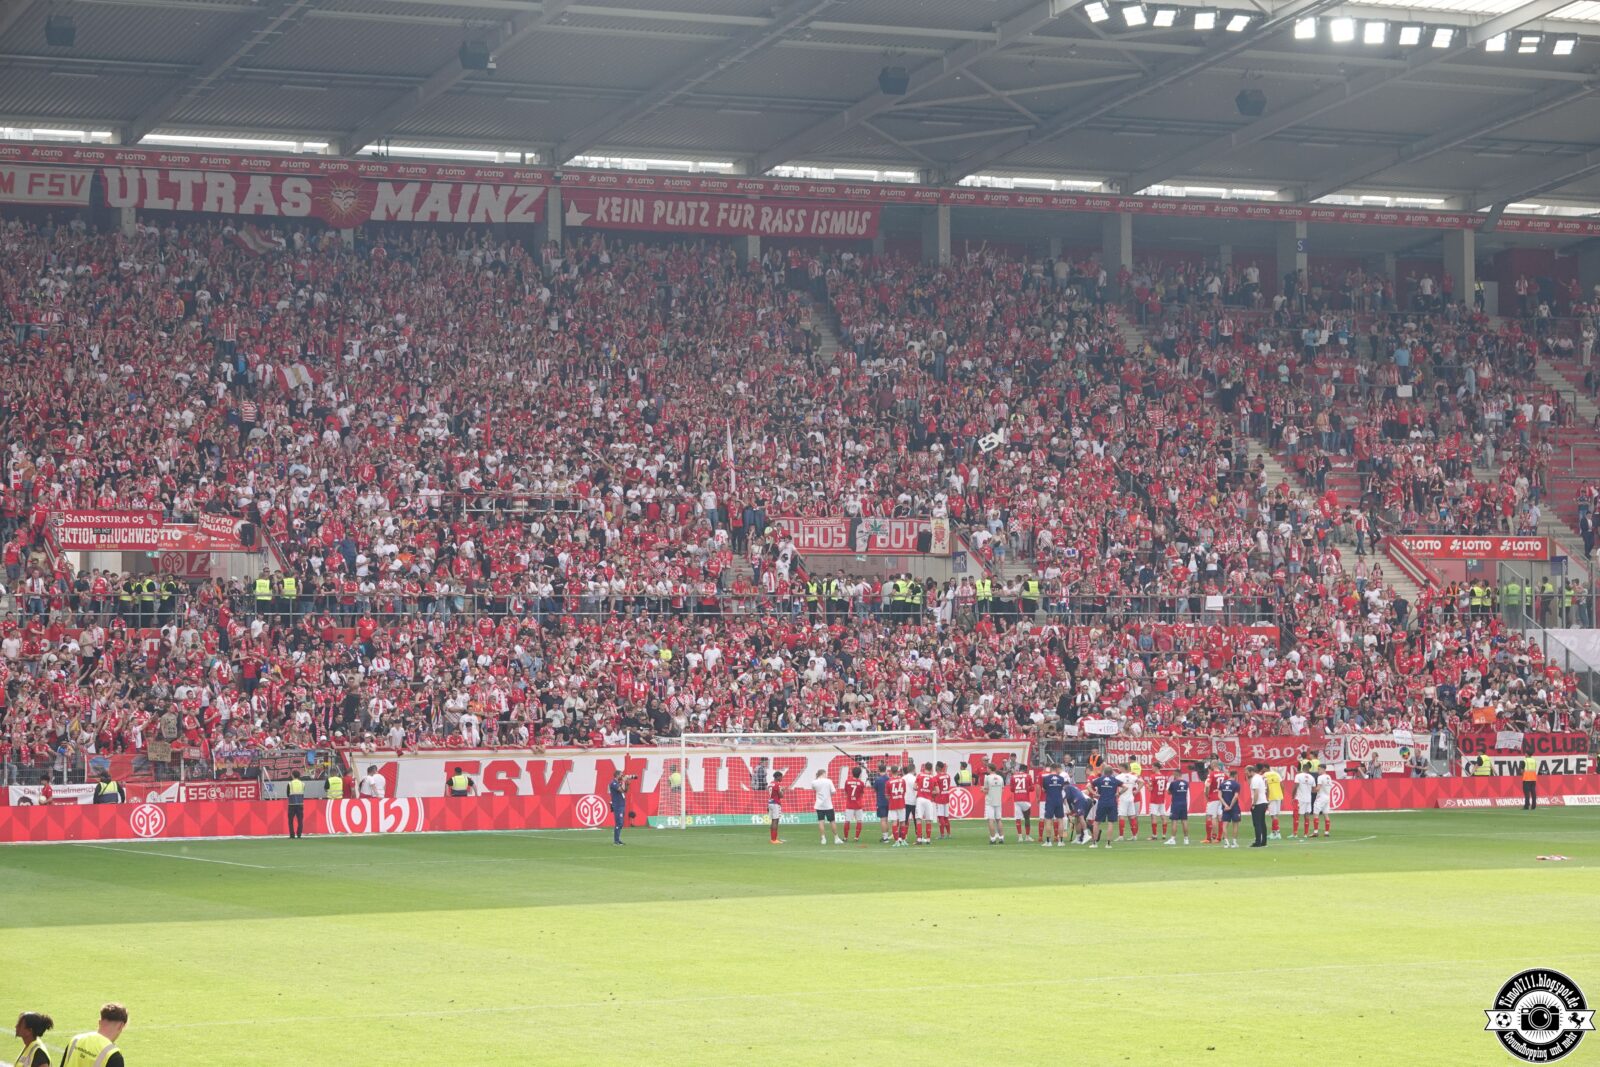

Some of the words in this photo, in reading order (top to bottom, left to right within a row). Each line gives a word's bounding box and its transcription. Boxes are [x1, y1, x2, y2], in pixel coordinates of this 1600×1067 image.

[28, 172, 86, 196] FSV
[103, 168, 312, 216] ULTRAS
[370, 182, 546, 222] MAINZ
[596, 196, 644, 224] KEIN
[653, 200, 710, 227] PLATZ
[716, 202, 755, 230] FÜR
[1297, 240, 1303, 251] S
[66, 514, 130, 523] SANDSTURM
[1412, 540, 1441, 550] LOTTO
[1462, 540, 1492, 550] LOTTO
[1512, 541, 1541, 550] LOTTO
[960, 554, 966, 568] R
[1107, 753, 1152, 764] metger
[923, 777, 930, 788] 6
[1015, 777, 1026, 790] 21
[234, 786, 255, 799] 122
[850, 785, 857, 796] 7
[892, 783, 904, 795] 44
